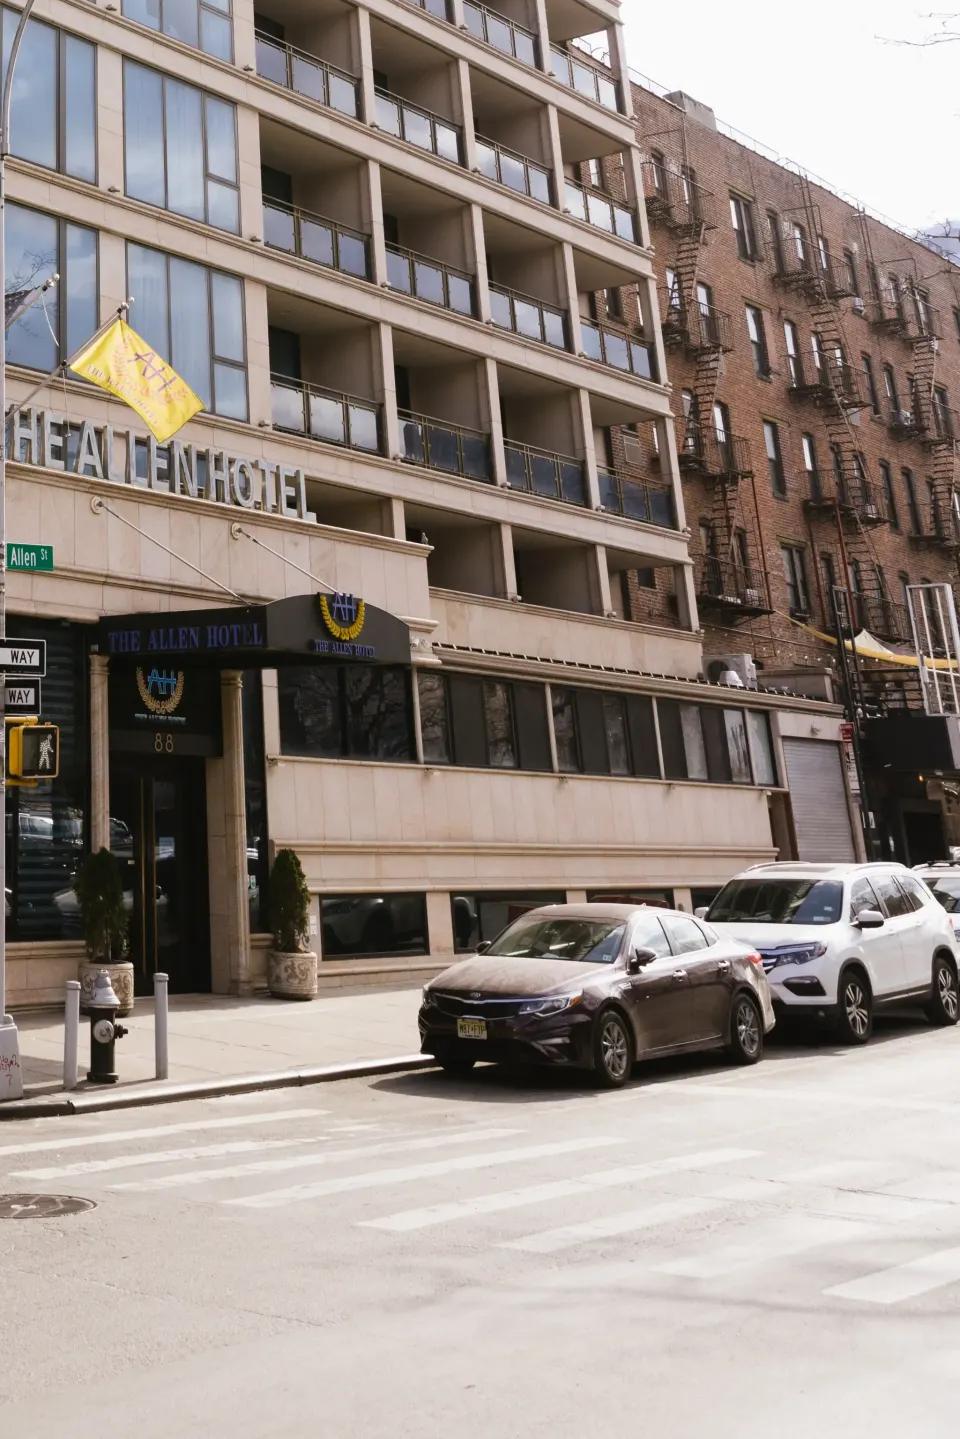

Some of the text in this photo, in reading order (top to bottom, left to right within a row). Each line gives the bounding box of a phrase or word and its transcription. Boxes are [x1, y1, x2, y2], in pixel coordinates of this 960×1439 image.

[73, 420, 199, 499] ALLEN
[204, 448, 317, 524] HOTEL
[11, 547, 48, 567] Allen St
[108, 623, 263, 653] THE ALLEN HOTEL
[10, 650, 35, 664] WAY
[315, 639, 379, 659] THE ALLEN HOTEL
[9, 690, 31, 703] WAY
[154, 732, 174, 753] 88
